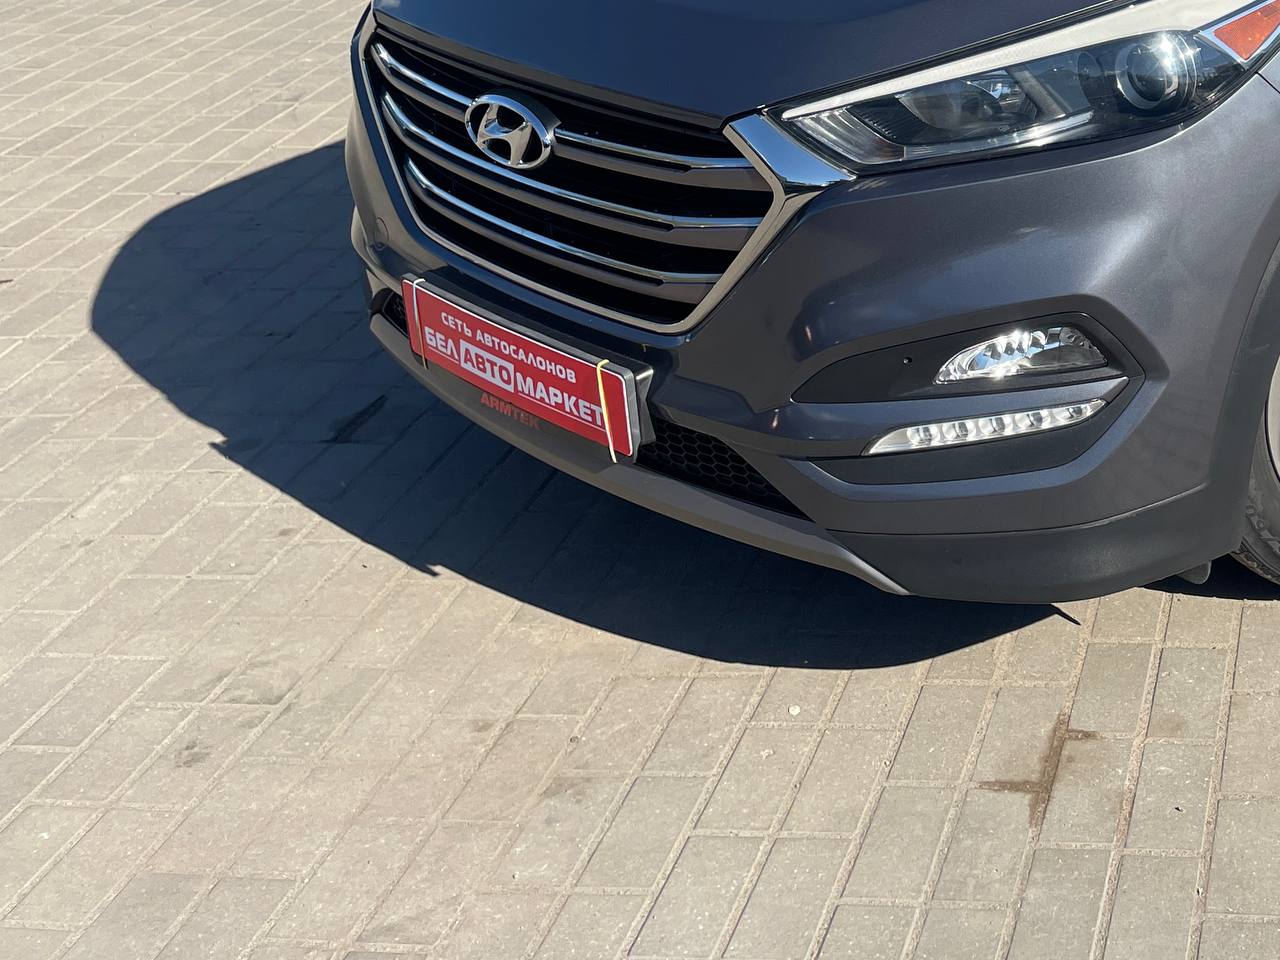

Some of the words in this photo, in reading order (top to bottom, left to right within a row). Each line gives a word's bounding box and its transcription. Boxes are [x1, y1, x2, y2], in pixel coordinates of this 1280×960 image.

[440, 311, 472, 338] СЕТЬ
[475, 328, 577, 384] АВТОСАЛОНОВ
[479, 392, 542, 430] ARMTEK
